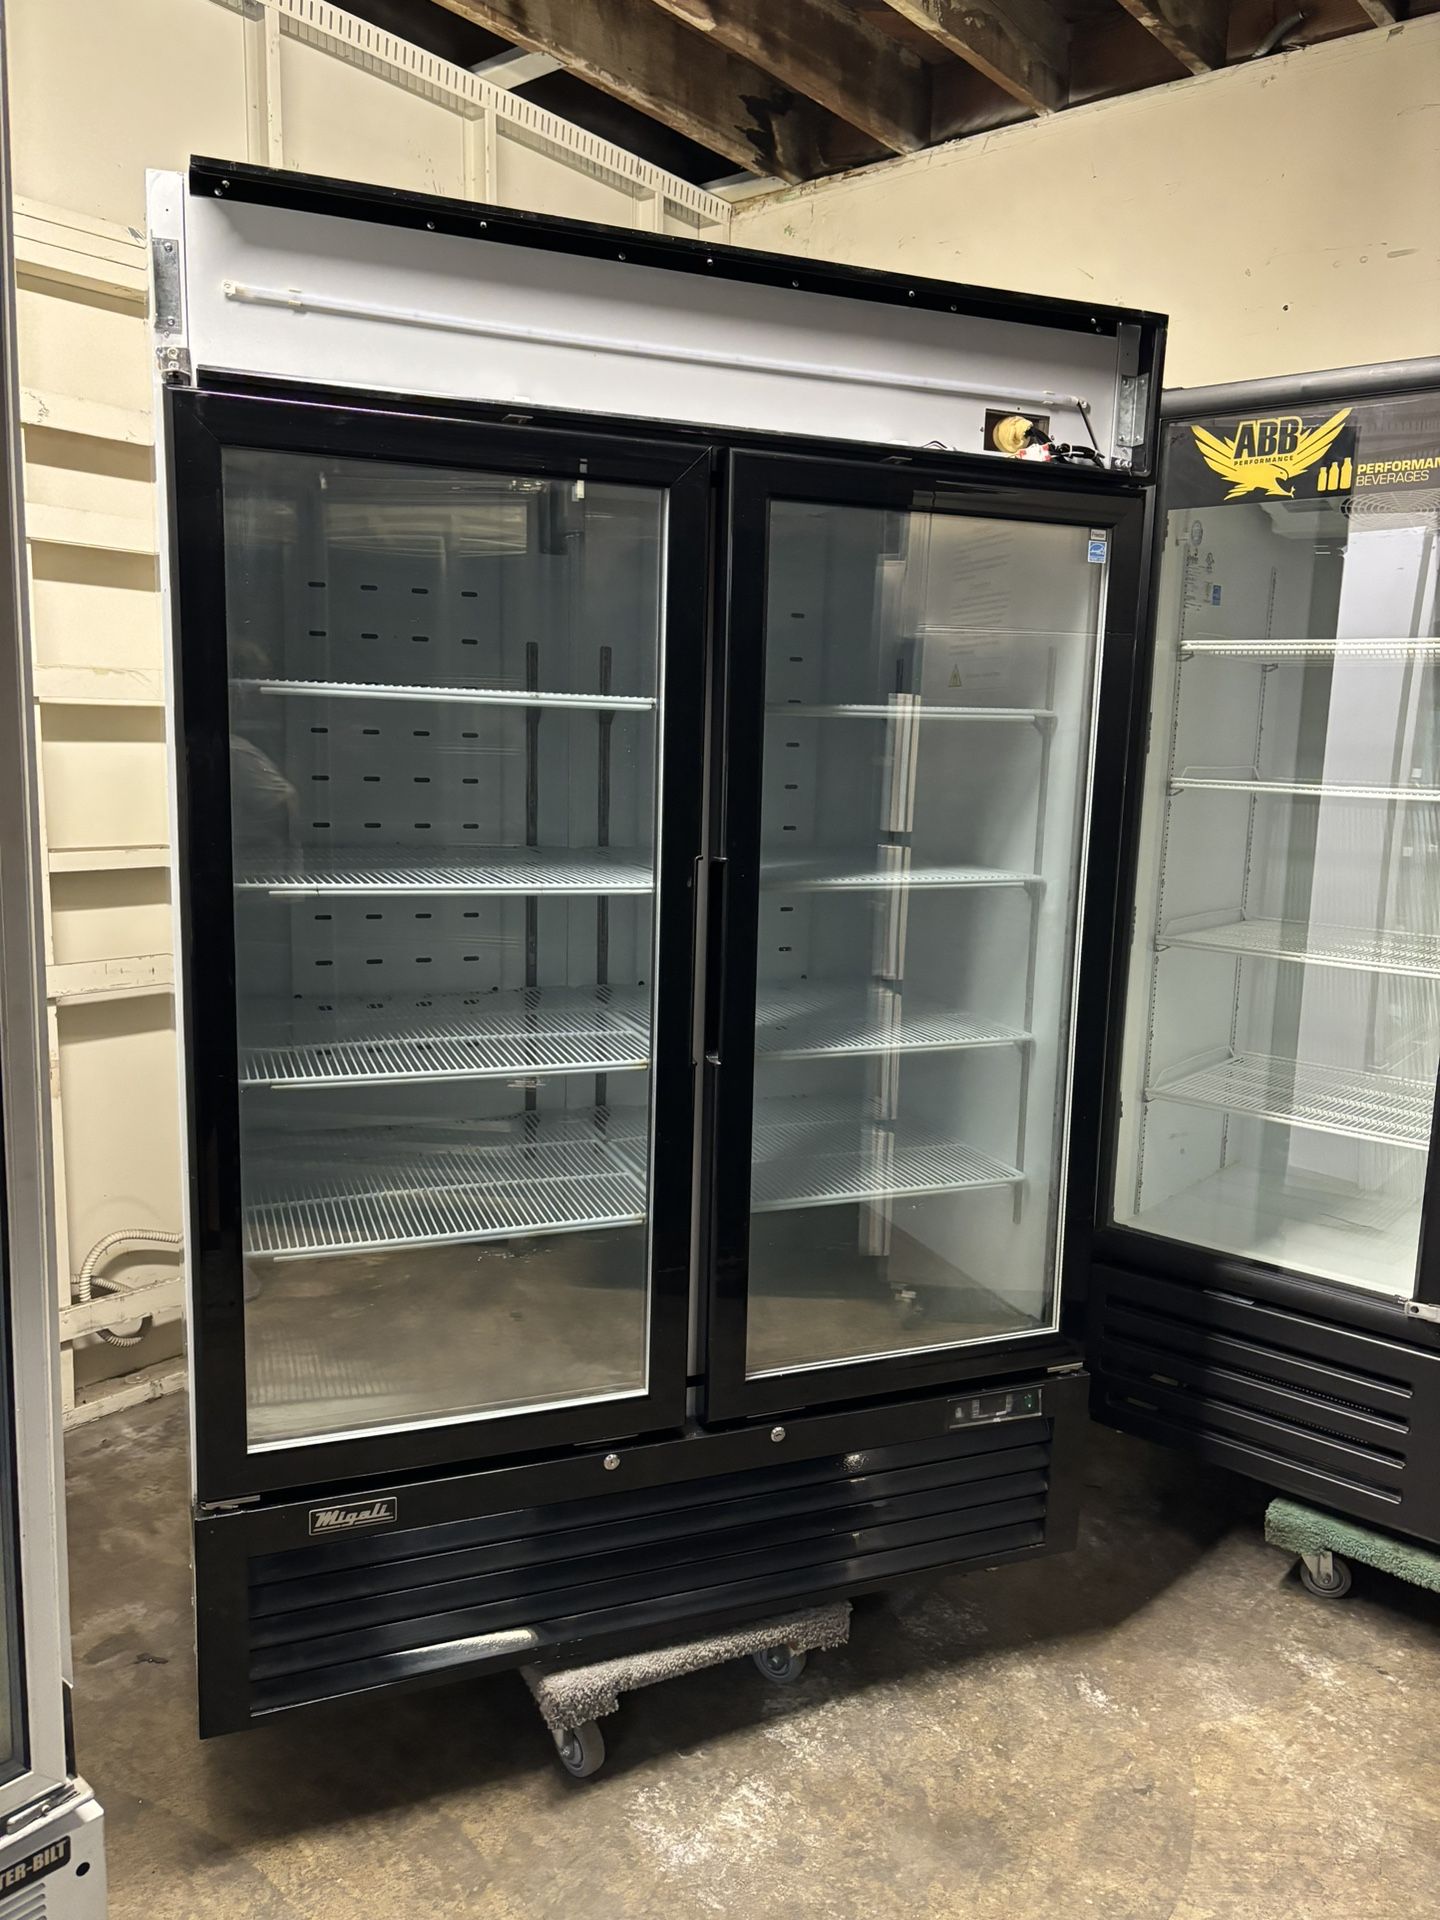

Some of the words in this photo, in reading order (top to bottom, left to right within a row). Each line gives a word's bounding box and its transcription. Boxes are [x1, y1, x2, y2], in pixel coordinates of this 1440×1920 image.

[1233, 416, 1302, 459] ABB
[1234, 455, 1294, 466] PERFORMANCE
[1355, 470, 1430, 487] BEVERAGES
